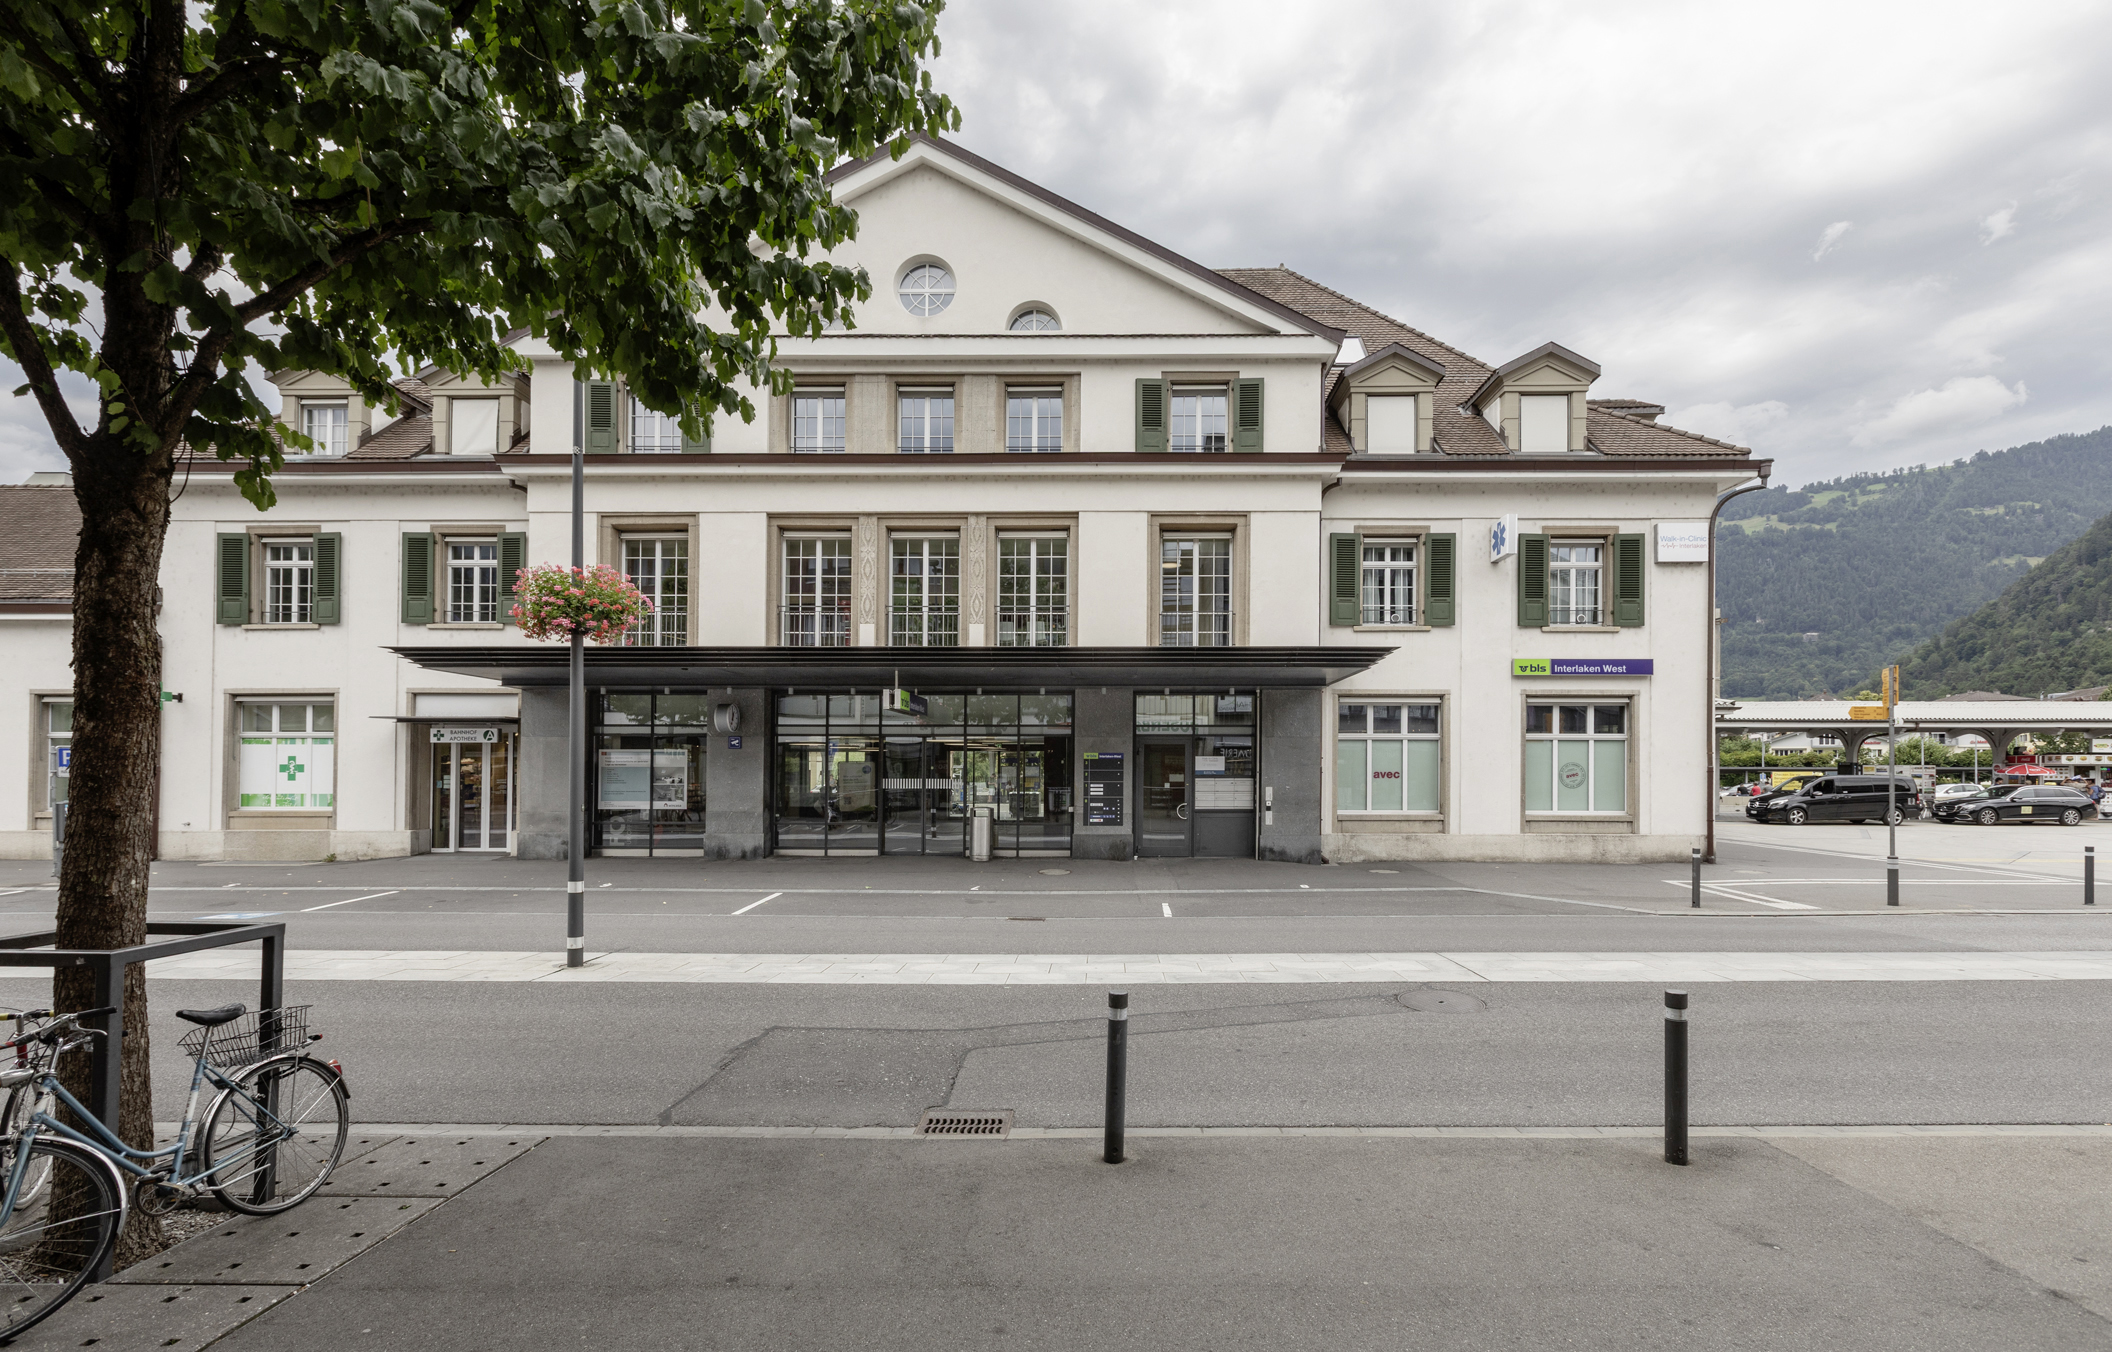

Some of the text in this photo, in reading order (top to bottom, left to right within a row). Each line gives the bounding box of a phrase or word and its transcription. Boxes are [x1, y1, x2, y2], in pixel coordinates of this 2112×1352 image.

[1530, 664, 1626, 672] bls Interlaken West
